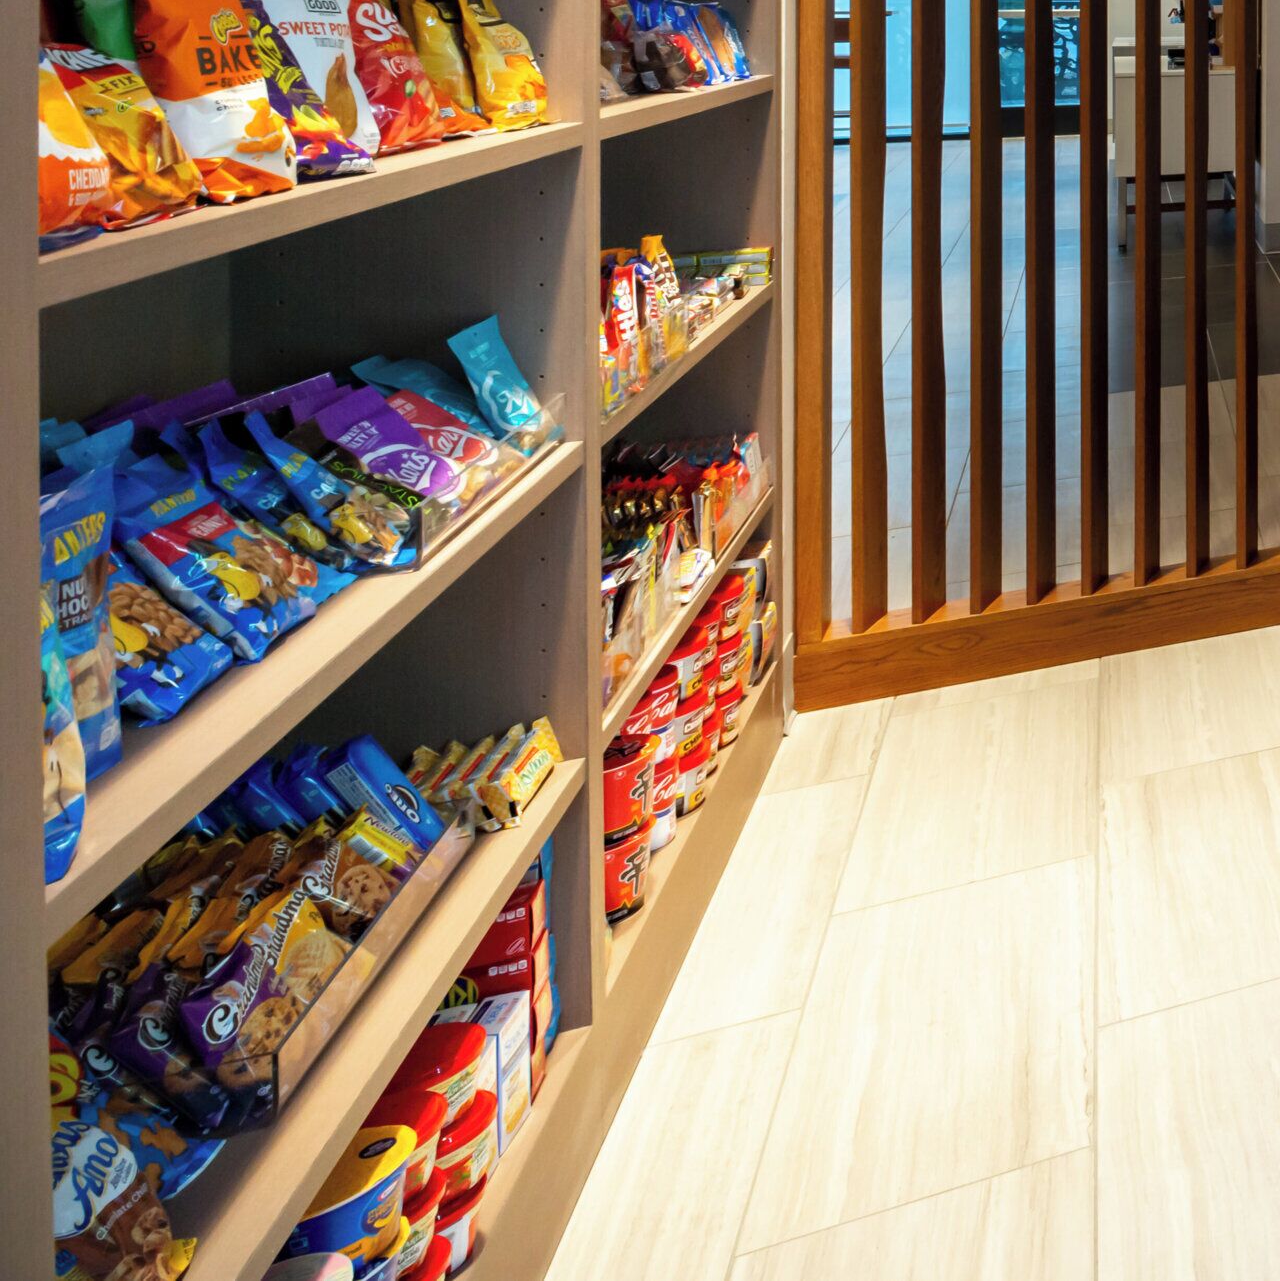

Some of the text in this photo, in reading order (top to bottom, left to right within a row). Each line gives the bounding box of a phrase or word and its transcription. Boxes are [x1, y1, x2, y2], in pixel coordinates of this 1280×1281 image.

[307, 0, 338, 11] GOOD
[280, 21, 326, 38] SWEET
[196, 46, 262, 76] BAKE
